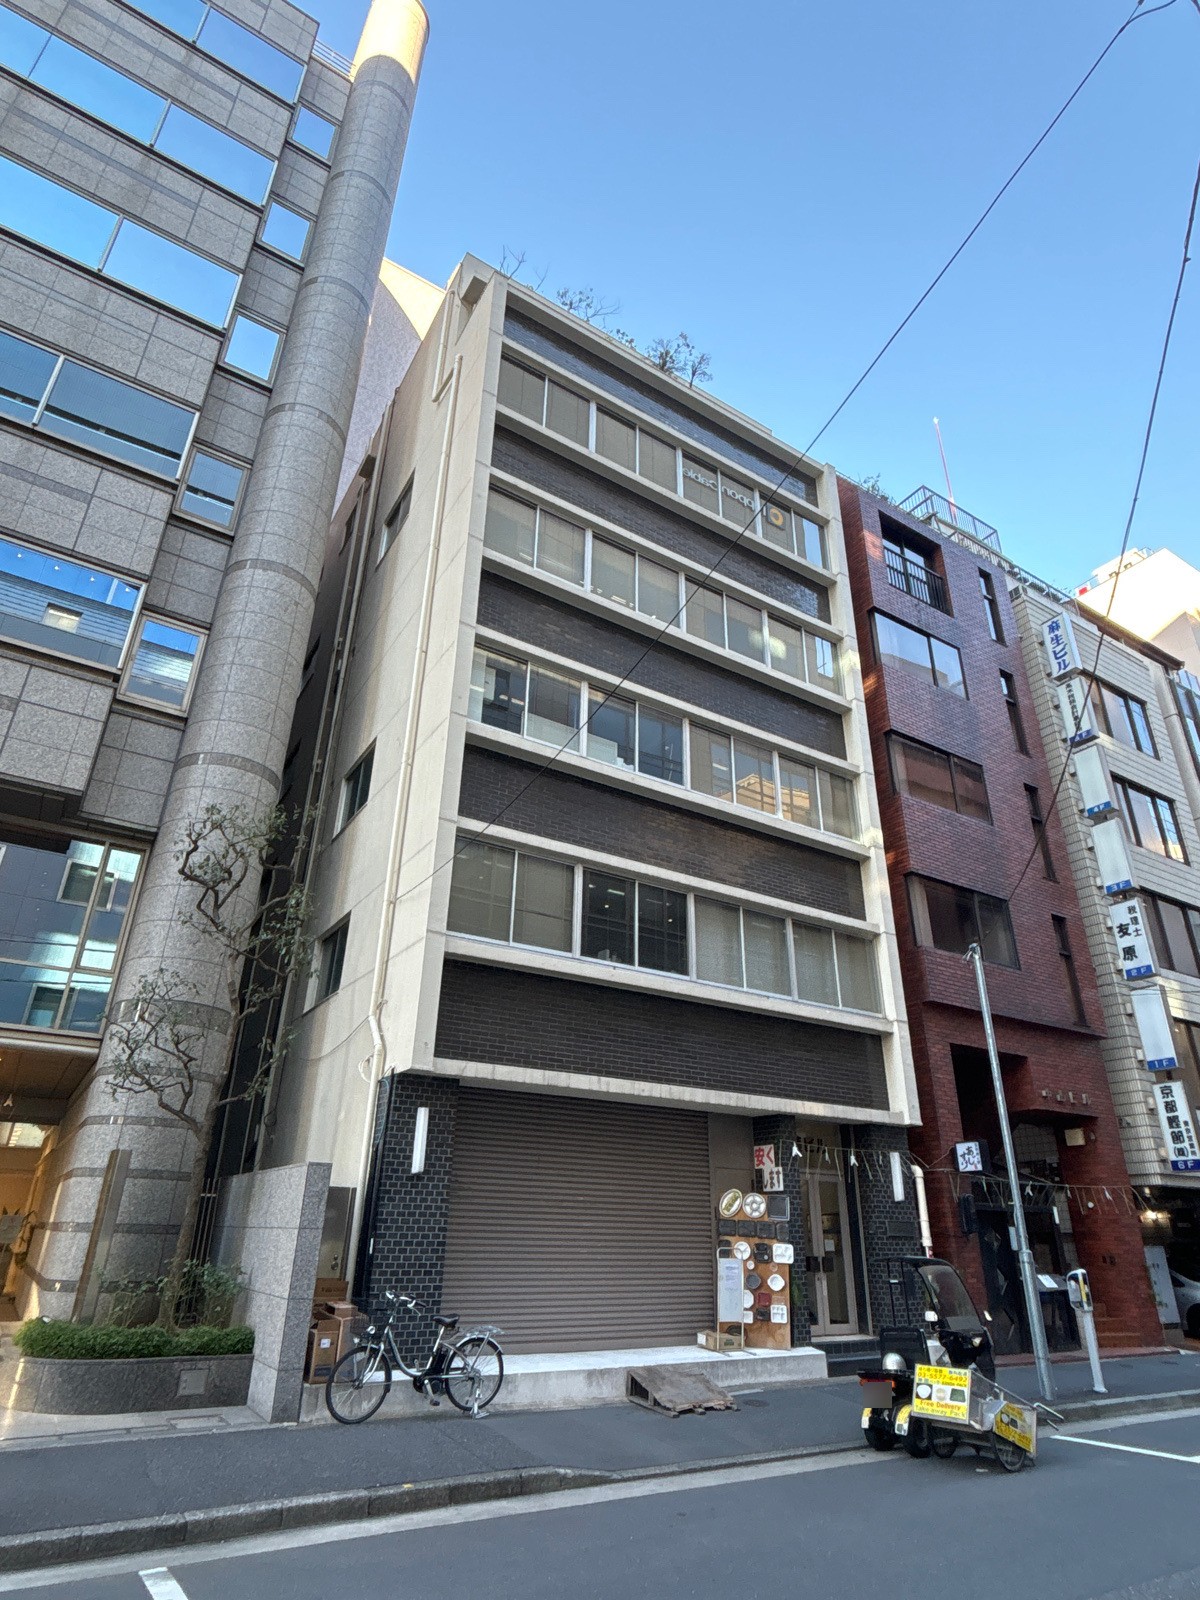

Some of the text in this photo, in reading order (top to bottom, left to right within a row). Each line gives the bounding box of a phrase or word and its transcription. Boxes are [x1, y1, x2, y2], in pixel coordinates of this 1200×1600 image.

[1047, 620, 1070, 674] 麻生ビル
[1111, 880, 1127, 892] 3F
[1127, 905, 1142, 937] 税理士
[1116, 922, 1138, 962] 友原
[1130, 966, 1147, 976] 2F
[1154, 1059, 1170, 1069] 1F
[754, 1146, 774, 1167] 安く
[1177, 1160, 1195, 1170] 6F
[763, 1168, 782, 1189] します
[917, 1371, 967, 1382] 03-5577-6492
[920, 1399, 962, 1411] Free Delivery
